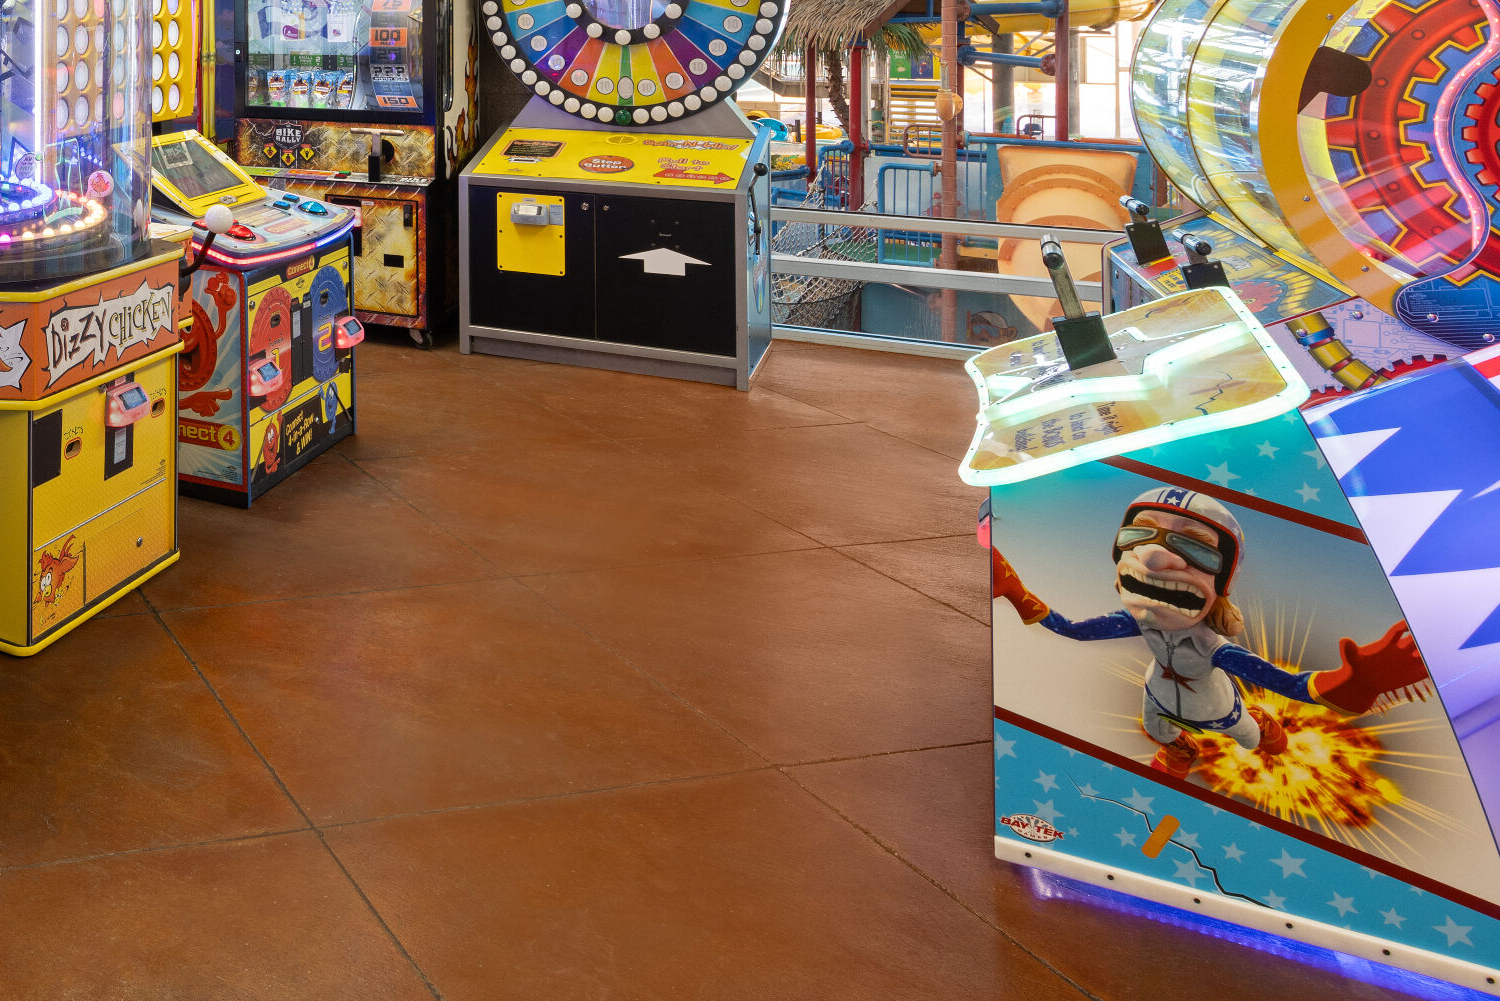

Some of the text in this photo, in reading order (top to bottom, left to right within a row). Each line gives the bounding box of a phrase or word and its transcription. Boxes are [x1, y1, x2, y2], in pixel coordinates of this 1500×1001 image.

[375, 30, 401, 41] 100
[693, 62, 703, 72] 10
[382, 97, 409, 105] 150
[275, 128, 301, 138] BIKE
[276, 135, 301, 144] RALLY
[318, 322, 332, 352] 2
[179, 424, 235, 446] nect 4
[1000, 817, 1066, 840] BAY TEK
